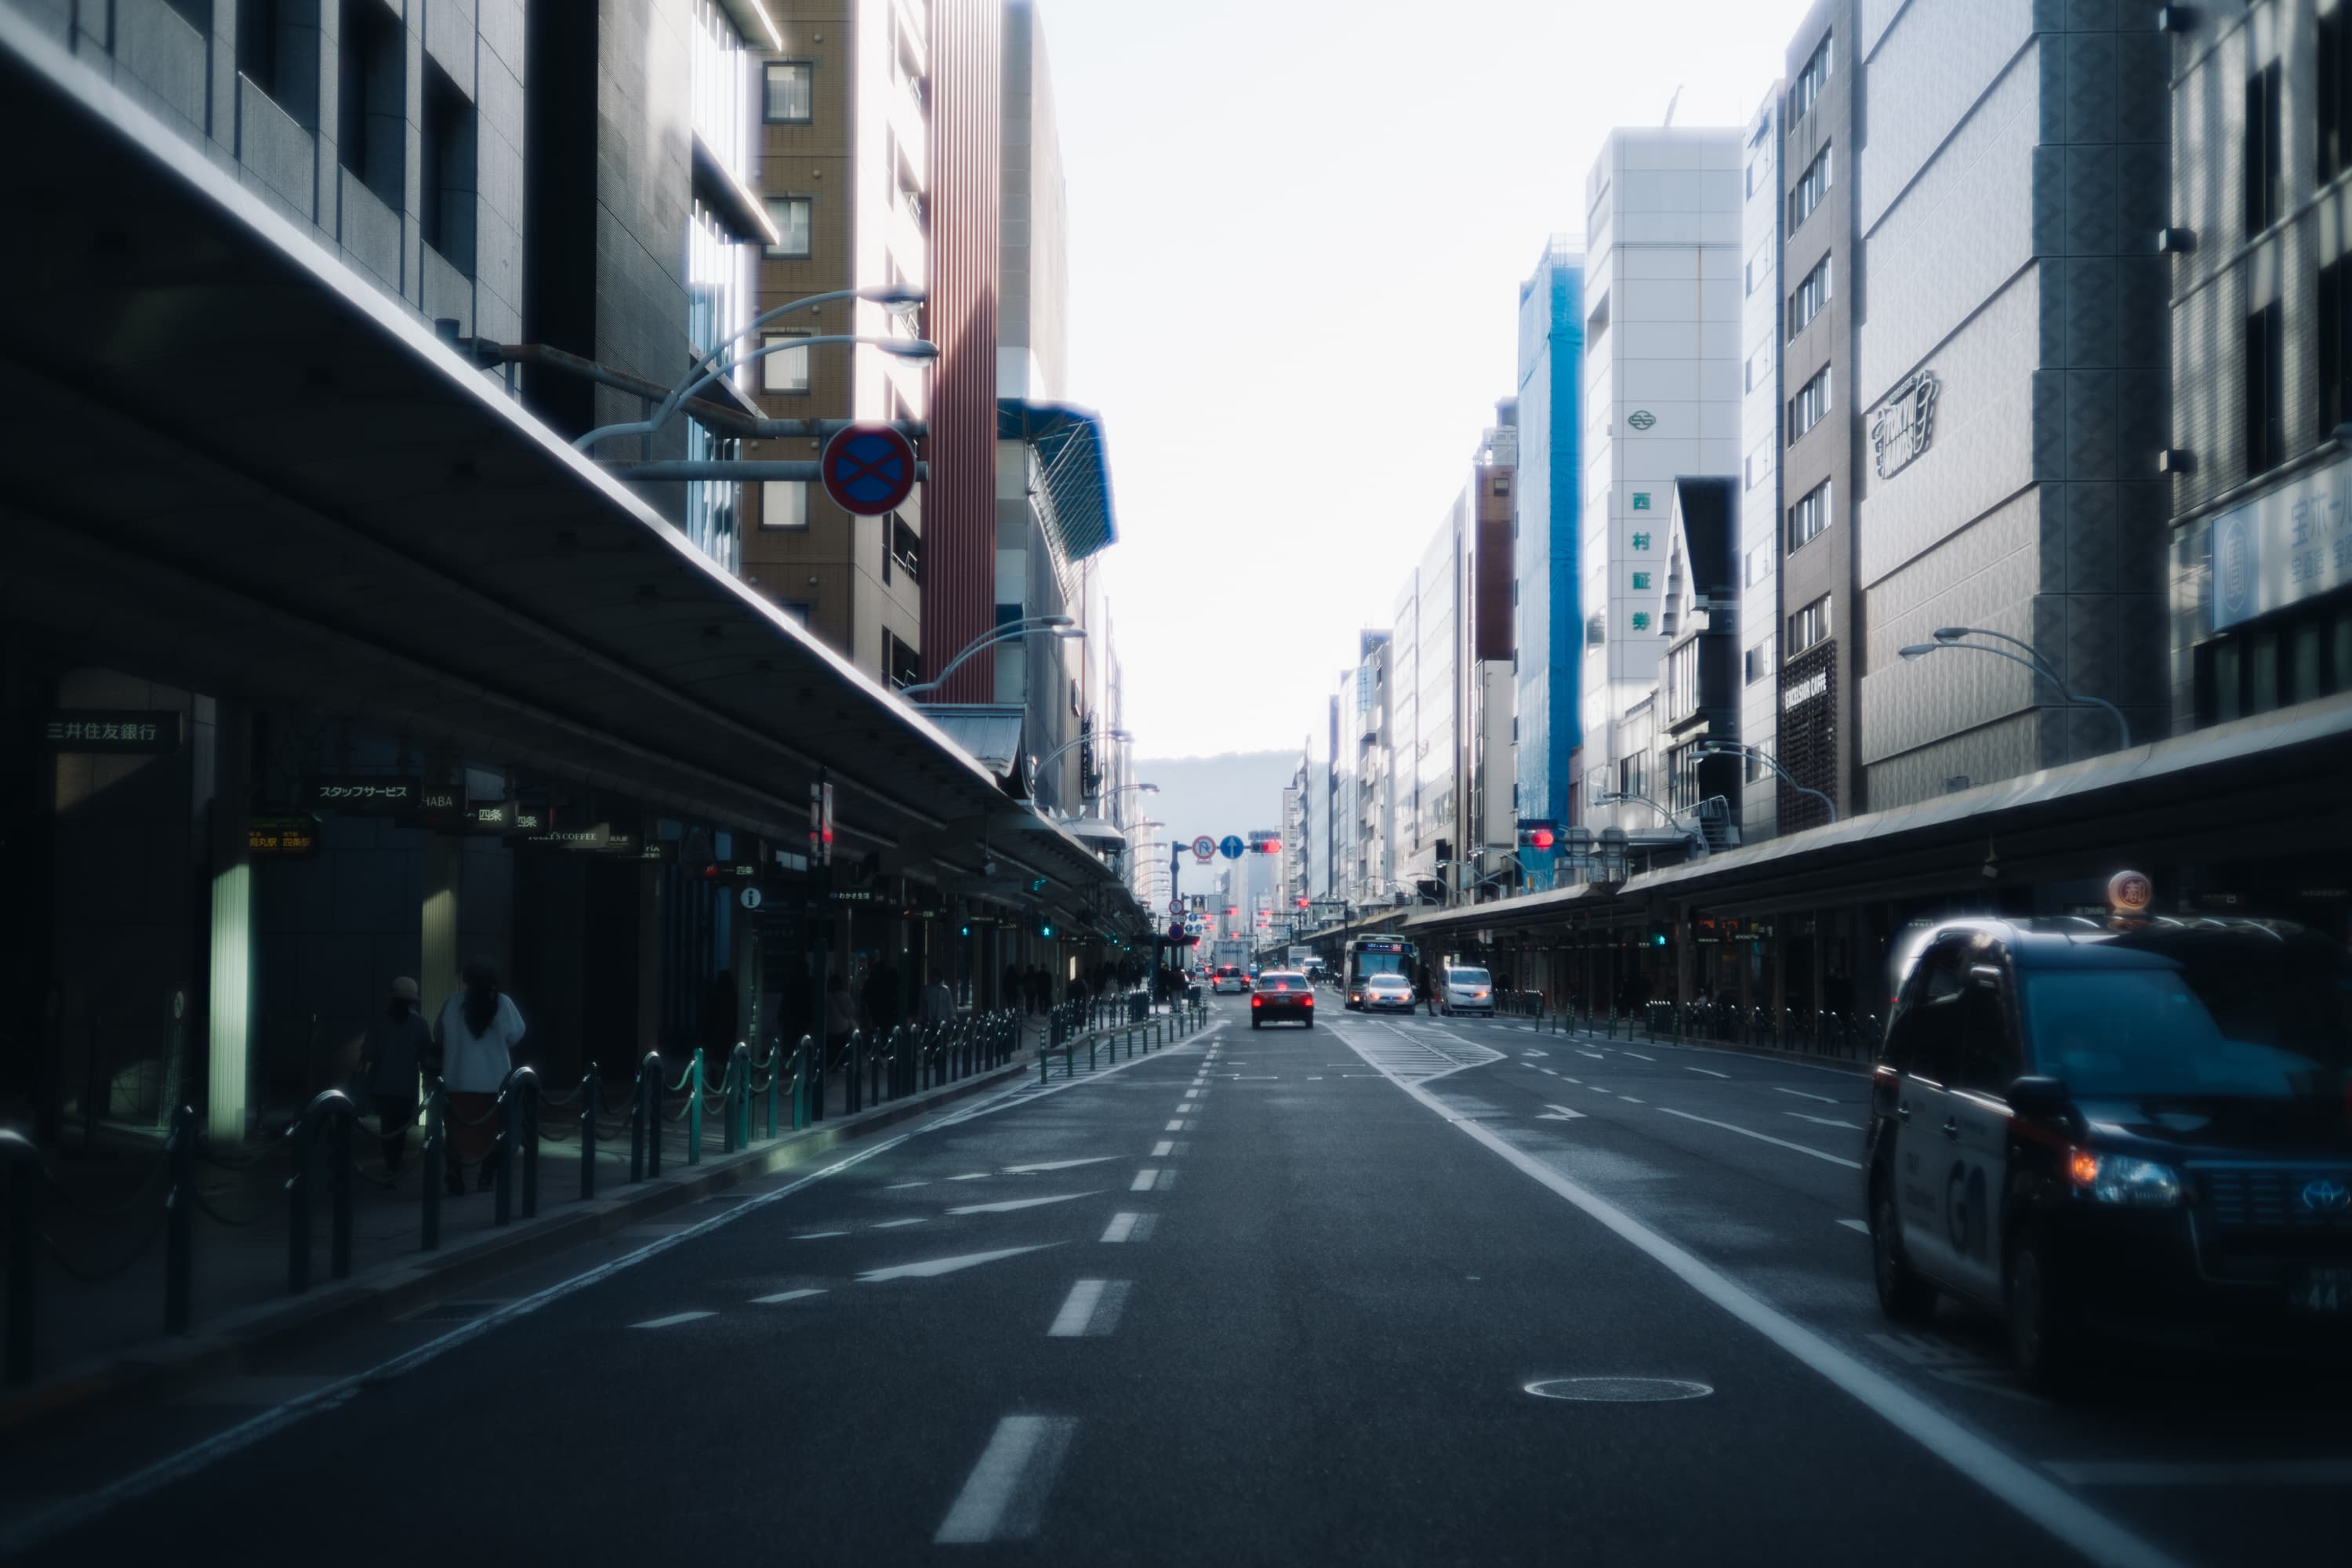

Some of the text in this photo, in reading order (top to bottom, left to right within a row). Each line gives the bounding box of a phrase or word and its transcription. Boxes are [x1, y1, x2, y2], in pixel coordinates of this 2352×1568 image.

[1632, 492, 1651, 630] 西村証券
[46, 722, 157, 740] 三井住友銀行
[319, 786, 407, 797] スタッフサービス
[478, 808, 503, 821] 四条
